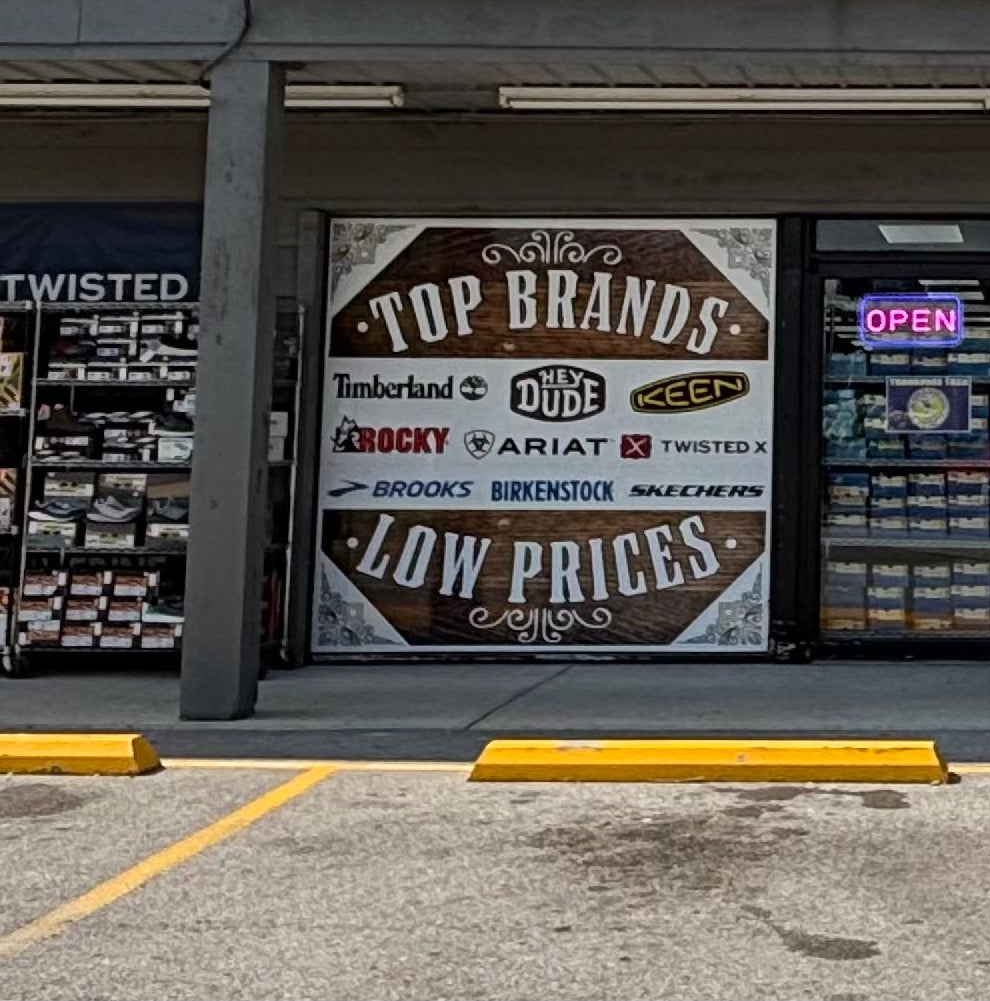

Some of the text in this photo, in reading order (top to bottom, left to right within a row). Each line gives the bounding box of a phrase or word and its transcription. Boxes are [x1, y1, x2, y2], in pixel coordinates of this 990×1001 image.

[0, 272, 189, 302] TWISTED
[369, 269, 729, 355] TOP BRANDS
[866, 308, 957, 332] OPEN
[331, 373, 454, 399] Timberland
[538, 369, 584, 388] HEY
[515, 377, 599, 418] DUDE
[637, 379, 743, 407] KEEN
[358, 427, 451, 454] ROCKY
[497, 437, 609, 456] ARIAT
[661, 440, 750, 455] TWISTED
[753, 440, 768, 455] X
[371, 480, 475, 498] BROOKS
[491, 479, 615, 503] BIRKENSTOCK
[628, 483, 767, 499] SKECHERS
[356, 513, 721, 604] LOW PRICES
